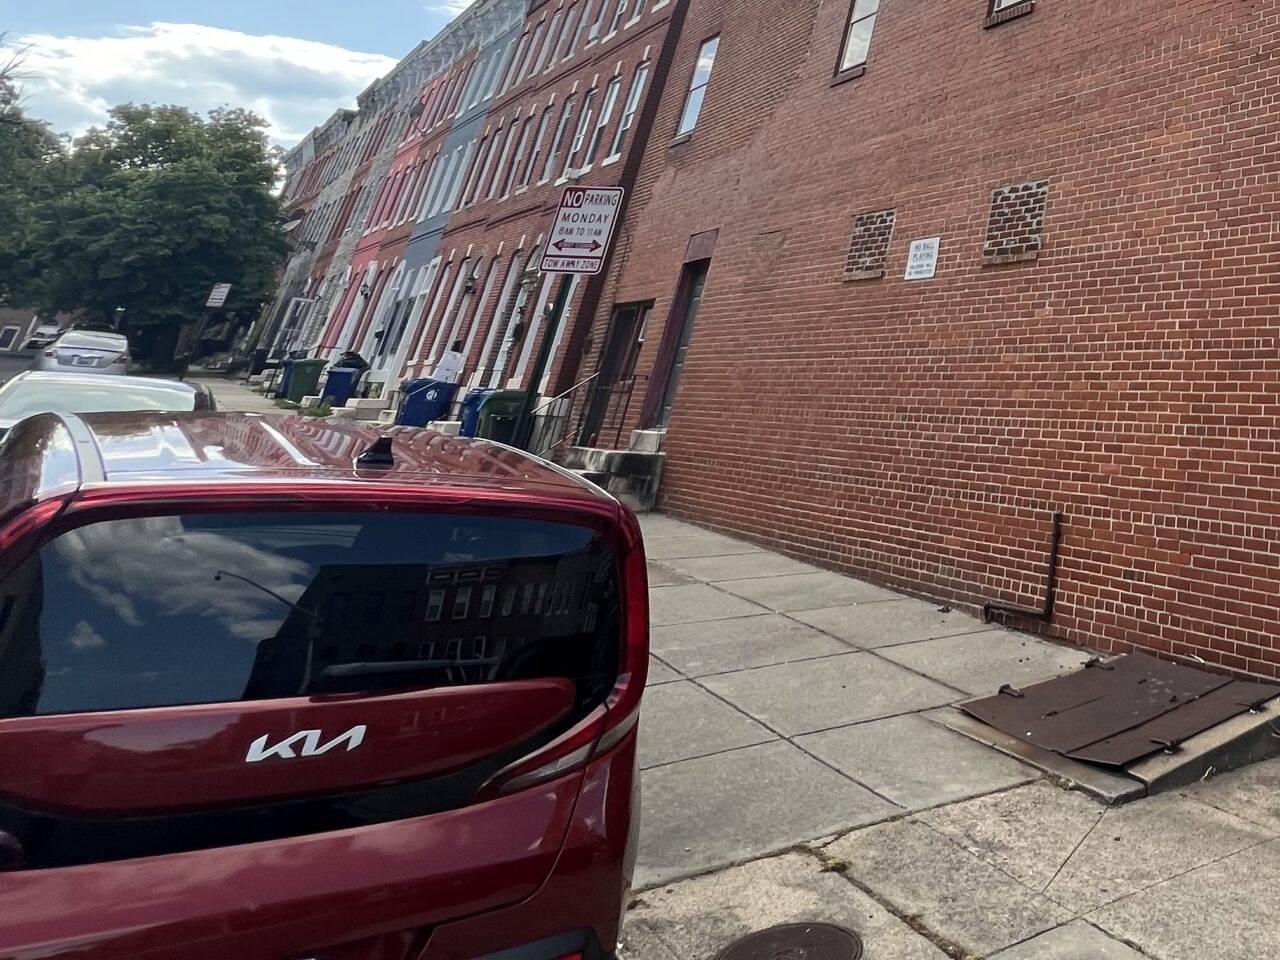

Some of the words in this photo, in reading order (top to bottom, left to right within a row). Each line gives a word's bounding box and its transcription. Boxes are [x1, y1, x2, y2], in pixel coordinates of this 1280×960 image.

[563, 191, 583, 207] NO
[584, 193, 618, 206] PARKING
[561, 212, 610, 224] MONDAY
[558, 227, 574, 235] 8AM
[576, 227, 585, 236] TO
[544, 259, 558, 268] TOW
[560, 259, 580, 269] AWAY
[581, 260, 598, 269] ZONE
[245, 725, 367, 762] KIA
